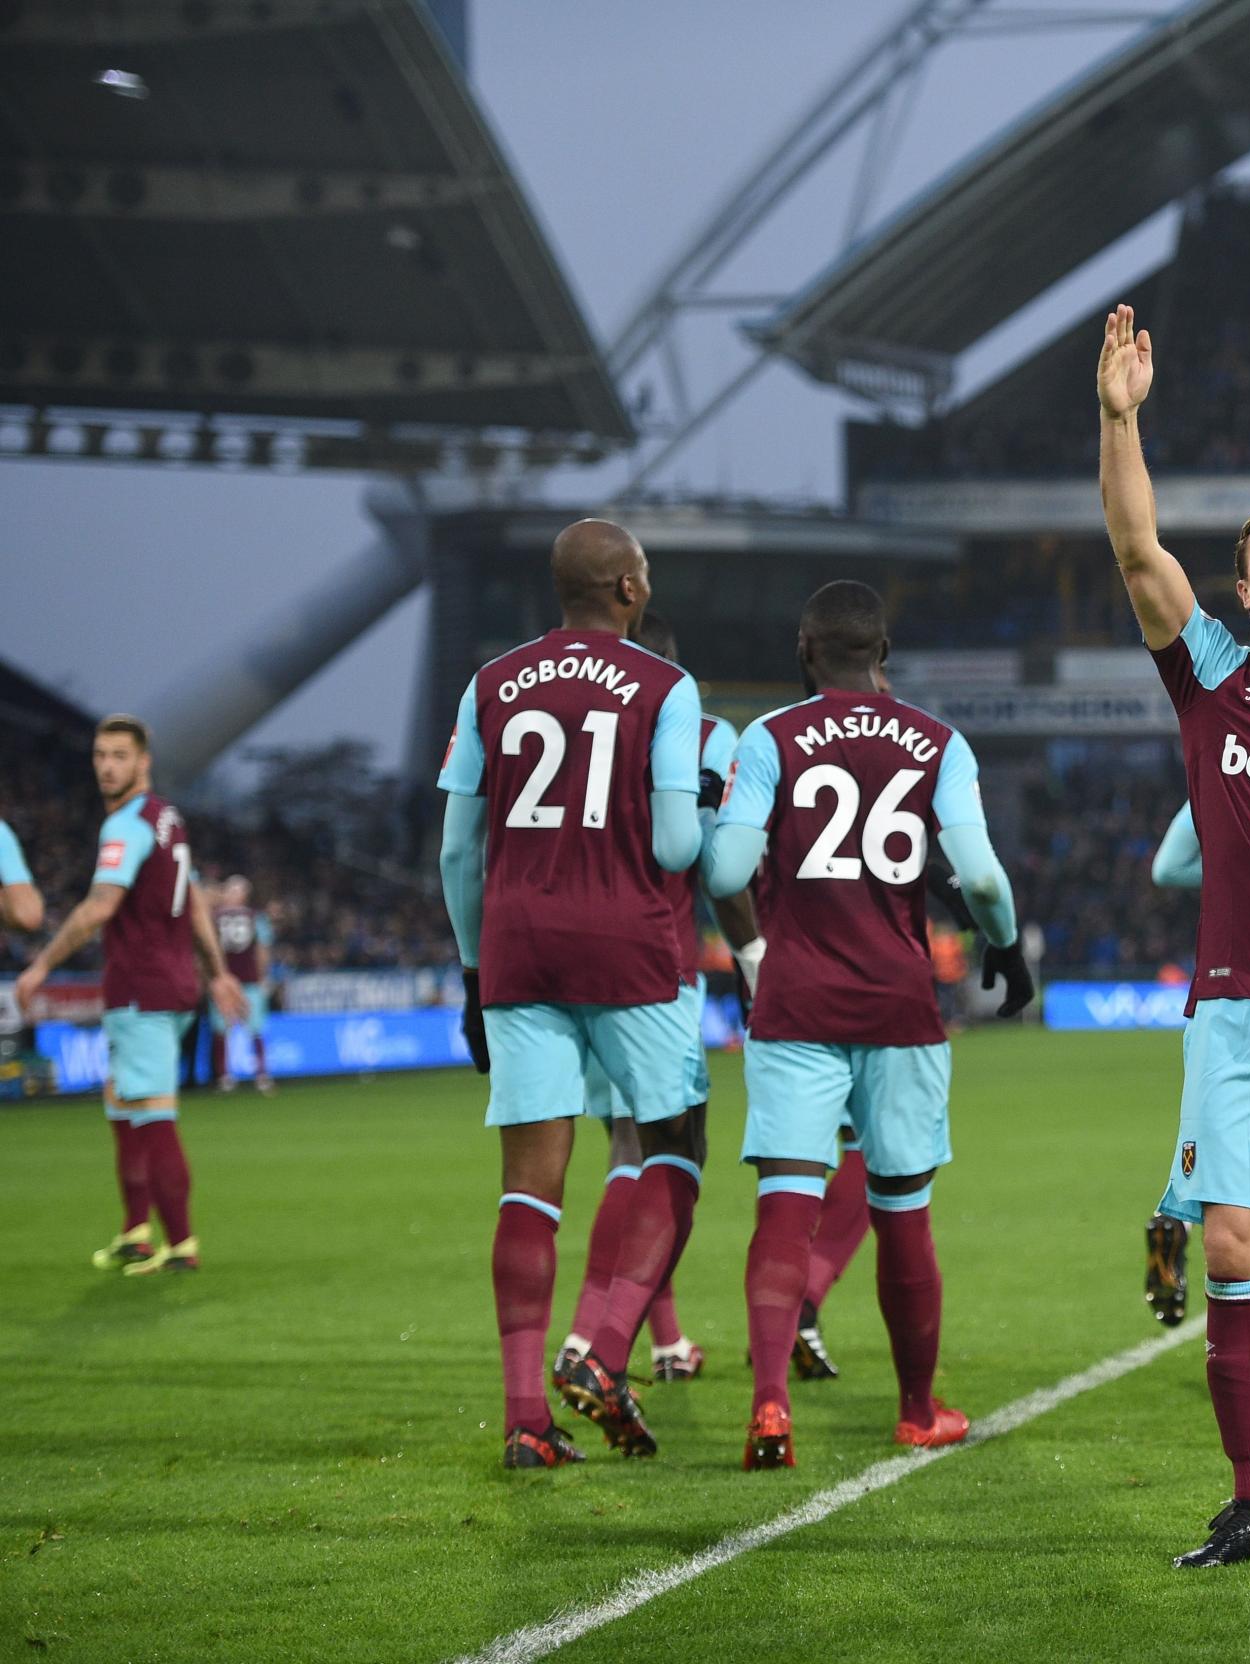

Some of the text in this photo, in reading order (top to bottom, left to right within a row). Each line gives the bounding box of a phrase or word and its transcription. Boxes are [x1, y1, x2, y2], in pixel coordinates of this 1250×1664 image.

[498, 656, 640, 706] OGBONNA
[501, 710, 619, 829] 21
[794, 715, 939, 763] MASUAKU
[793, 764, 928, 885] 26
